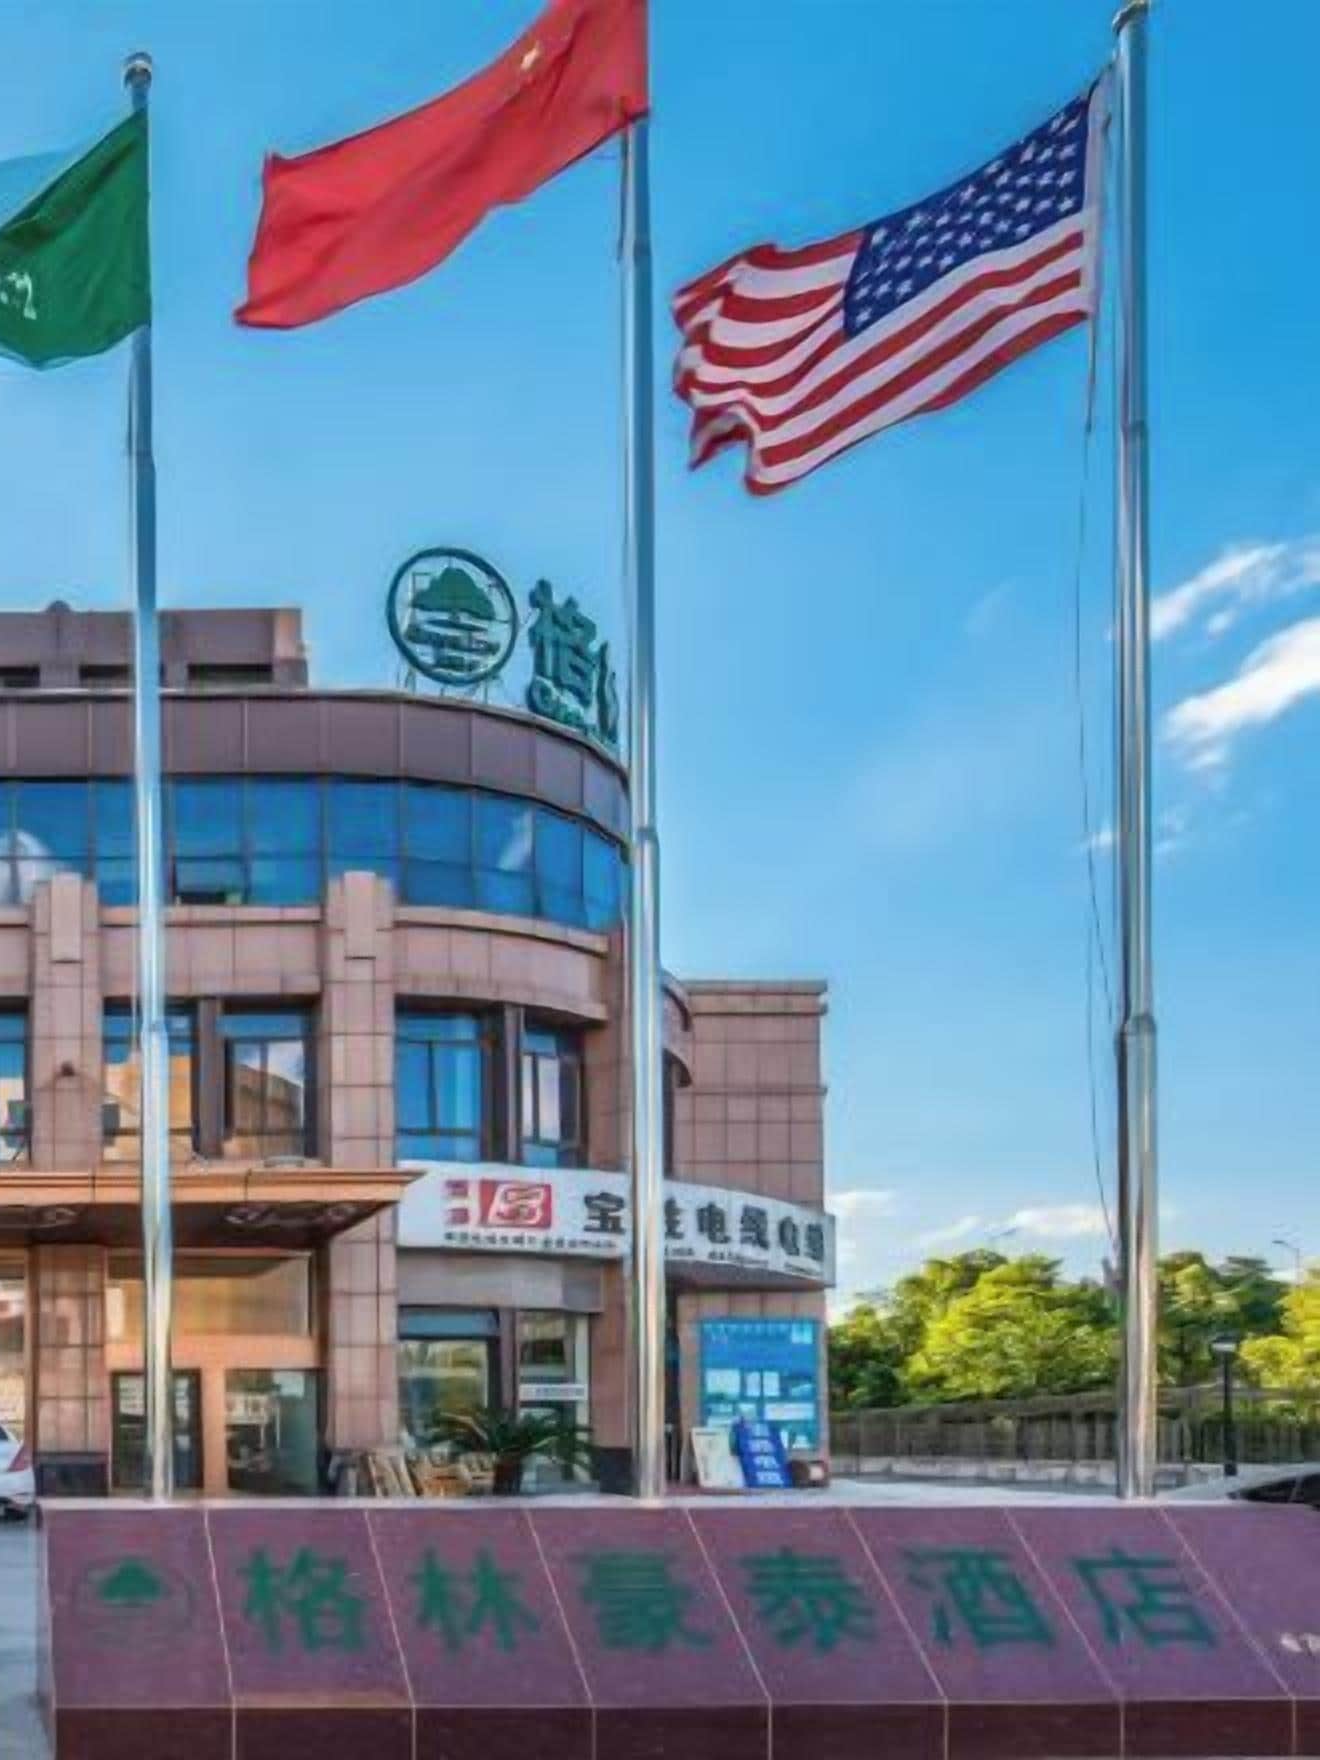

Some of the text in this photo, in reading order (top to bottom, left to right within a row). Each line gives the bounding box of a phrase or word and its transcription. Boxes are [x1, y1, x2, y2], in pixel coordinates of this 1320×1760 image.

[236, 1544, 1220, 1656] 格林豪泰酒店
